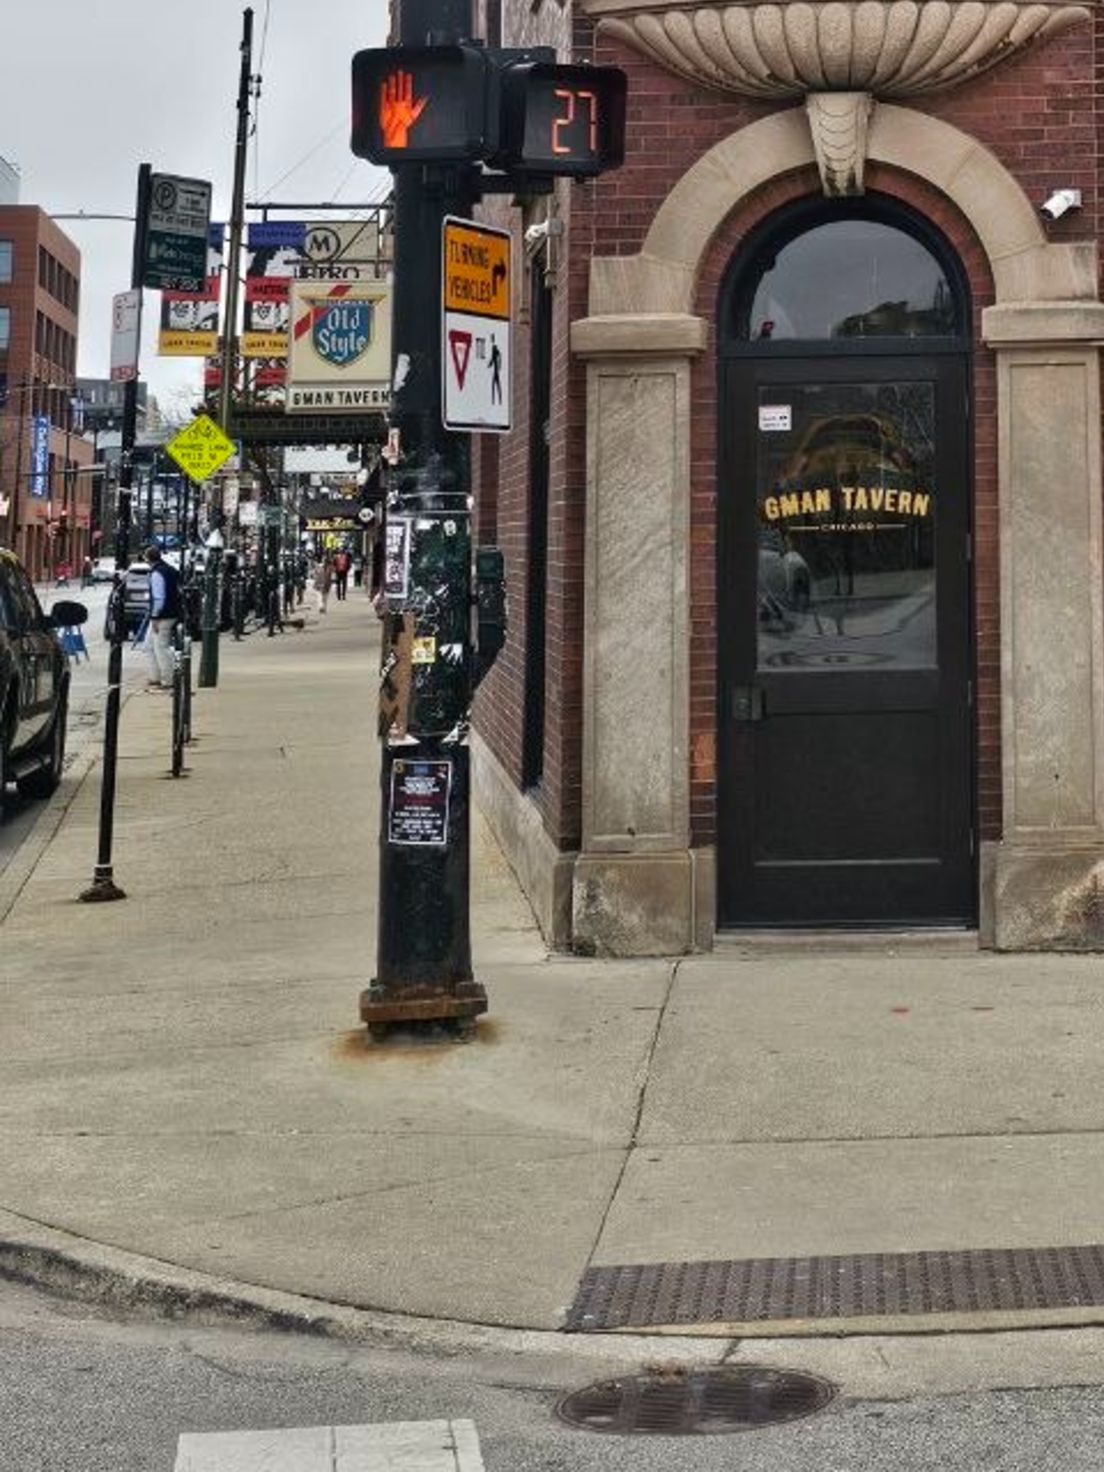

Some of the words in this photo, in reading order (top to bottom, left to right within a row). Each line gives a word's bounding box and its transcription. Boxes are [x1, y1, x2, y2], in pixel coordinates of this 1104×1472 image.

[553, 89, 596, 154] 27
[309, 235, 331, 252] M
[450, 239, 489, 270] TURNING
[449, 276, 491, 305] VEHICLES
[327, 307, 360, 328] Old
[318, 330, 367, 361] Style
[293, 391, 334, 406] GMAN
[338, 389, 390, 405] TAVERN
[764, 488, 831, 521] GMAN
[841, 487, 930, 517] TAVERN
